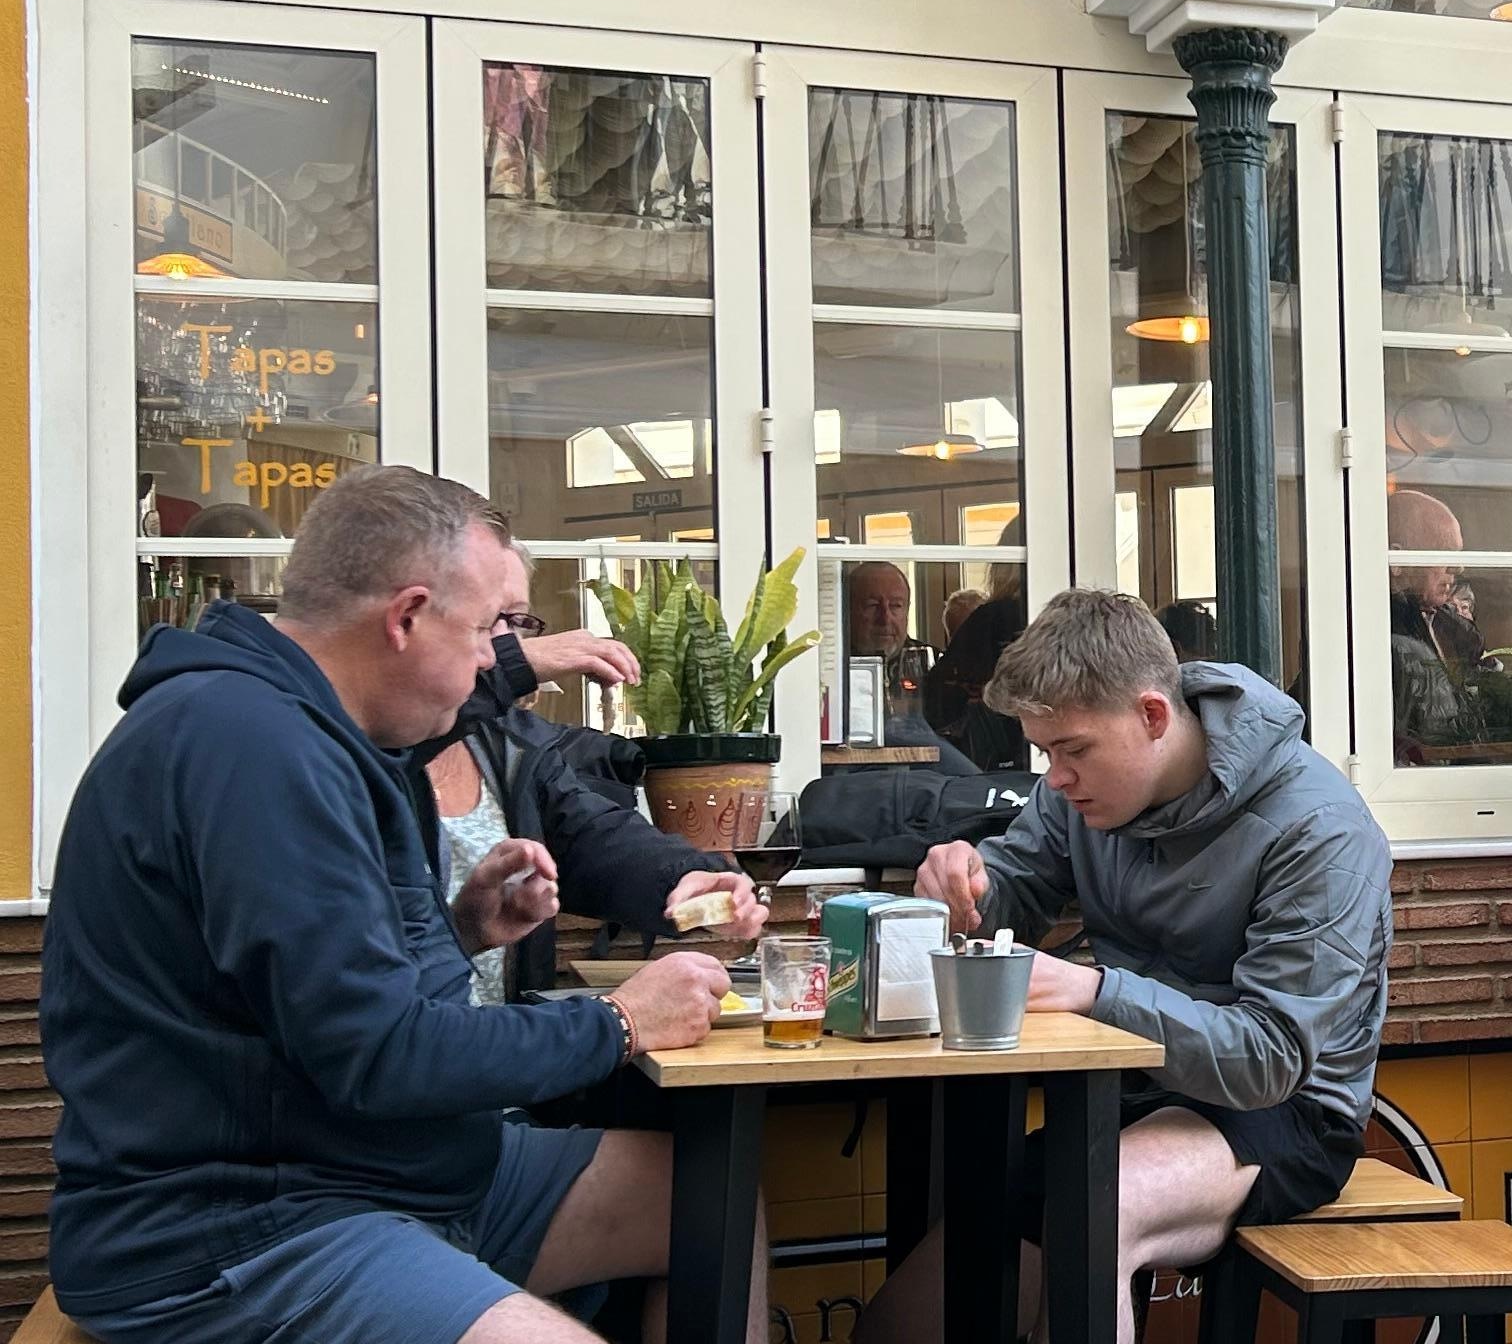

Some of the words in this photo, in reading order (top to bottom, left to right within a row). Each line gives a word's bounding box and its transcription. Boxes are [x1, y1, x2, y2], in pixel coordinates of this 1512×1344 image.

[180, 321, 337, 396] Tapas
[180, 436, 337, 509] Tapas
[635, 492, 680, 508] SALIDA
